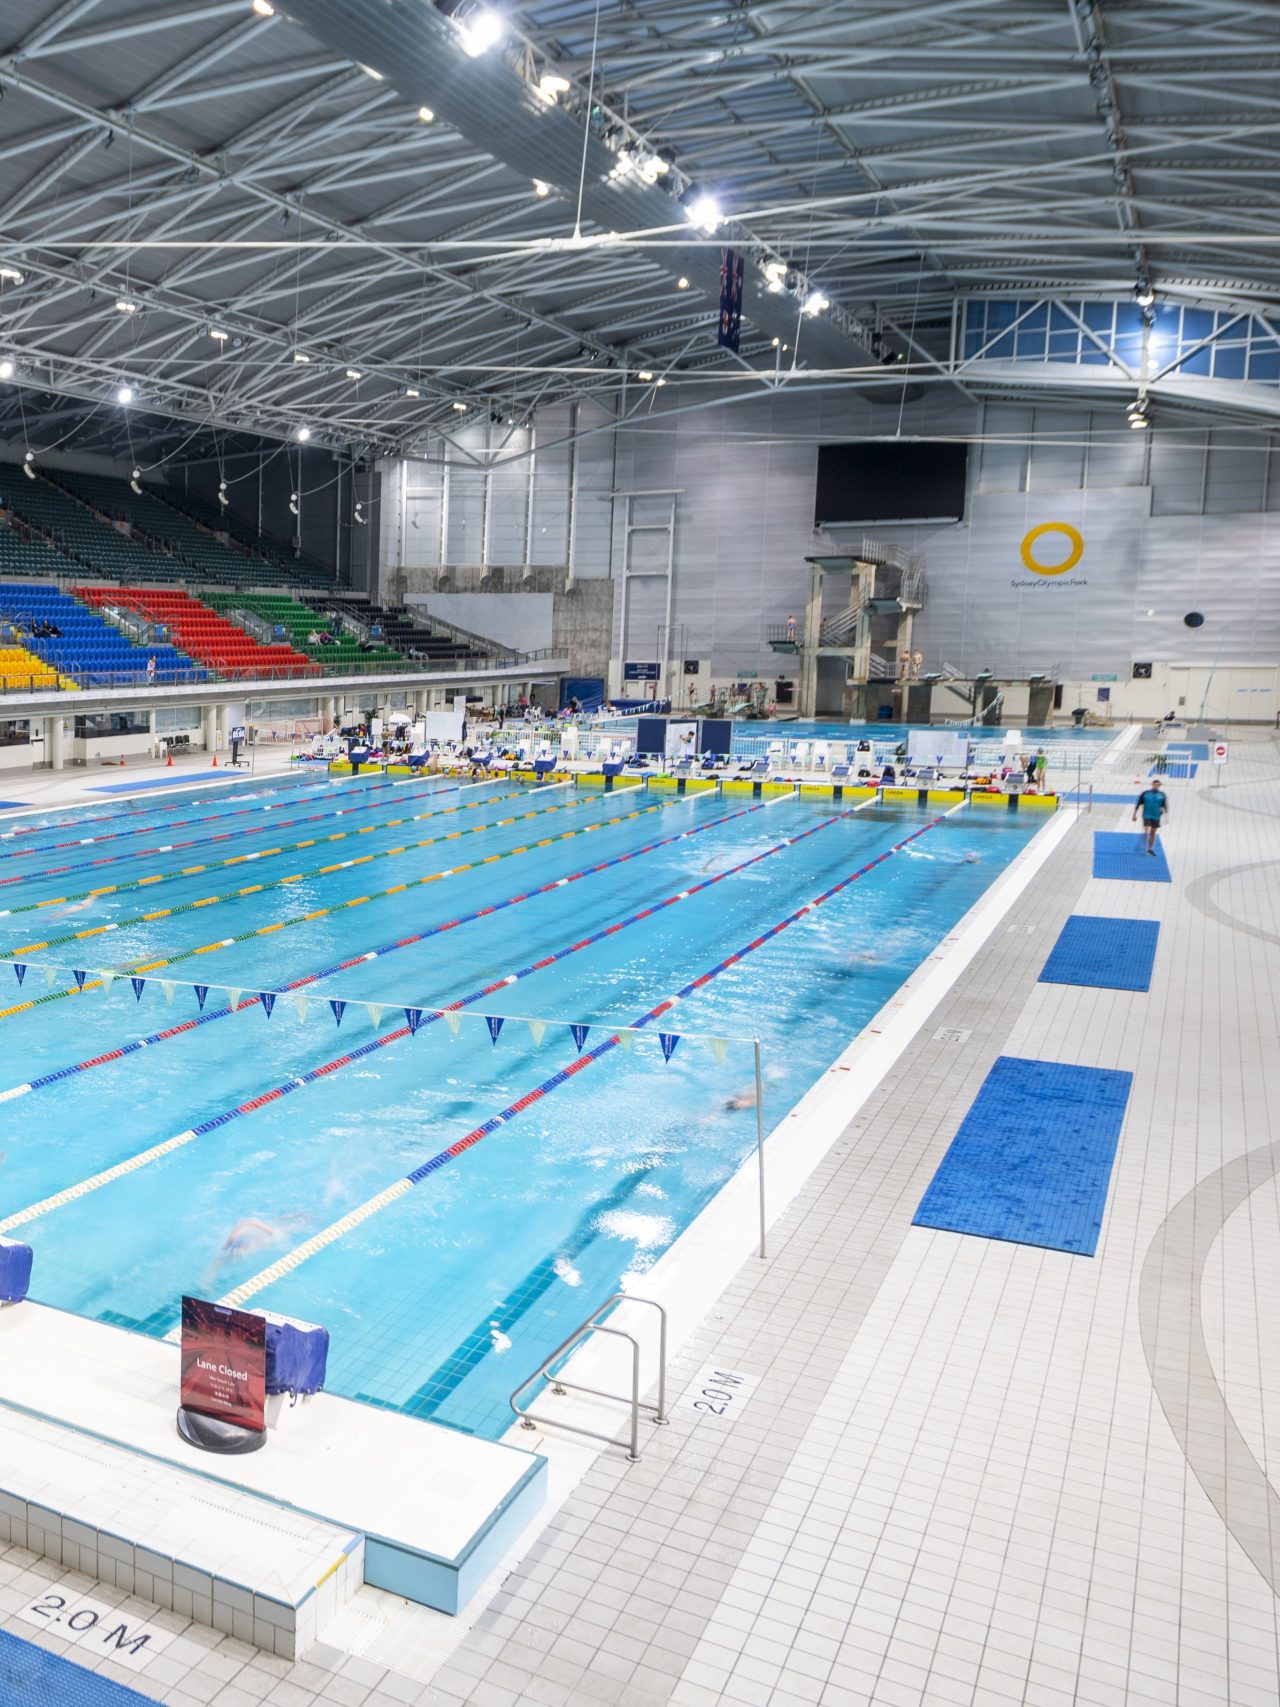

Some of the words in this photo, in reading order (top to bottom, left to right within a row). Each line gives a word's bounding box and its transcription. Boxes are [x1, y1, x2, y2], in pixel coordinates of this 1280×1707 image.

[196, 1358, 217, 1372] Lane
[218, 1365, 248, 1382] Closed
[709, 1371, 744, 1388] M
[693, 1389, 732, 1415] 2.0
[30, 1595, 99, 1631] 2.0
[103, 1624, 151, 1654] M
